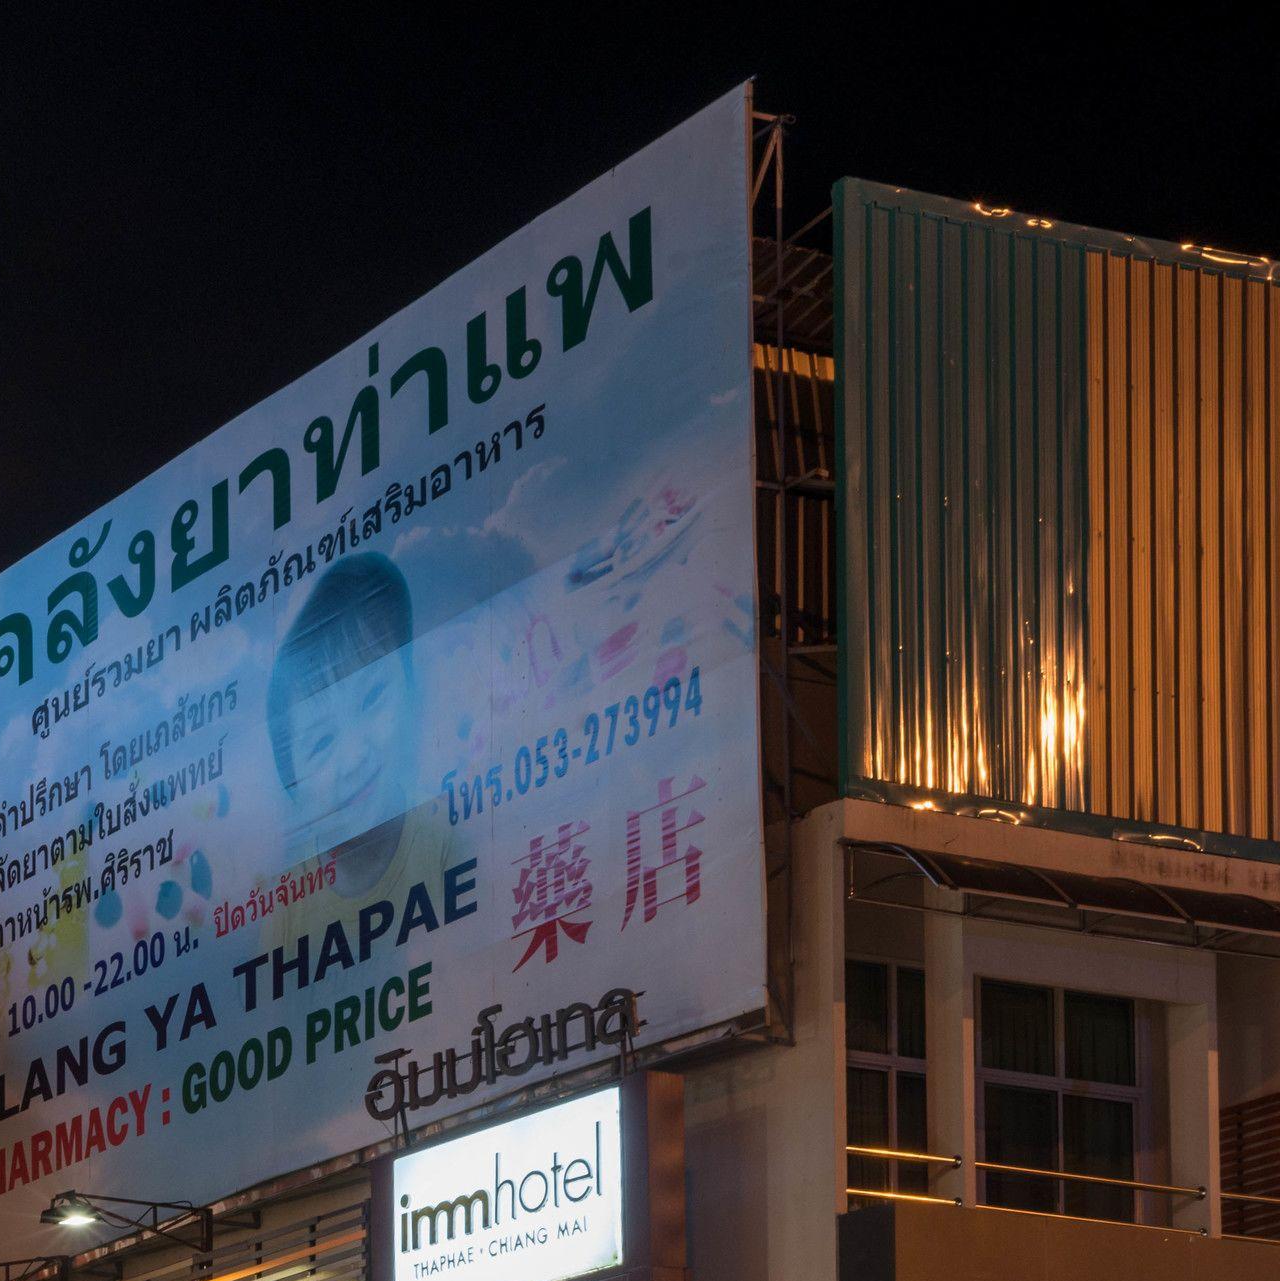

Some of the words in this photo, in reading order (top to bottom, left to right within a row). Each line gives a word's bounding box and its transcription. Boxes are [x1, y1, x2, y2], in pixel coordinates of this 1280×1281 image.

[7, 976, 76, 1037] 10.00
[144, 981, 218, 1053] YA
[232, 856, 478, 1014] THAPAE
[180, 1020, 297, 1116] GOOD
[305, 962, 433, 1065] PRICE
[413, 1246, 475, 1281] THAPHAE
[488, 1227, 548, 1257] CHIANG
[556, 1215, 588, 1240] MAI
